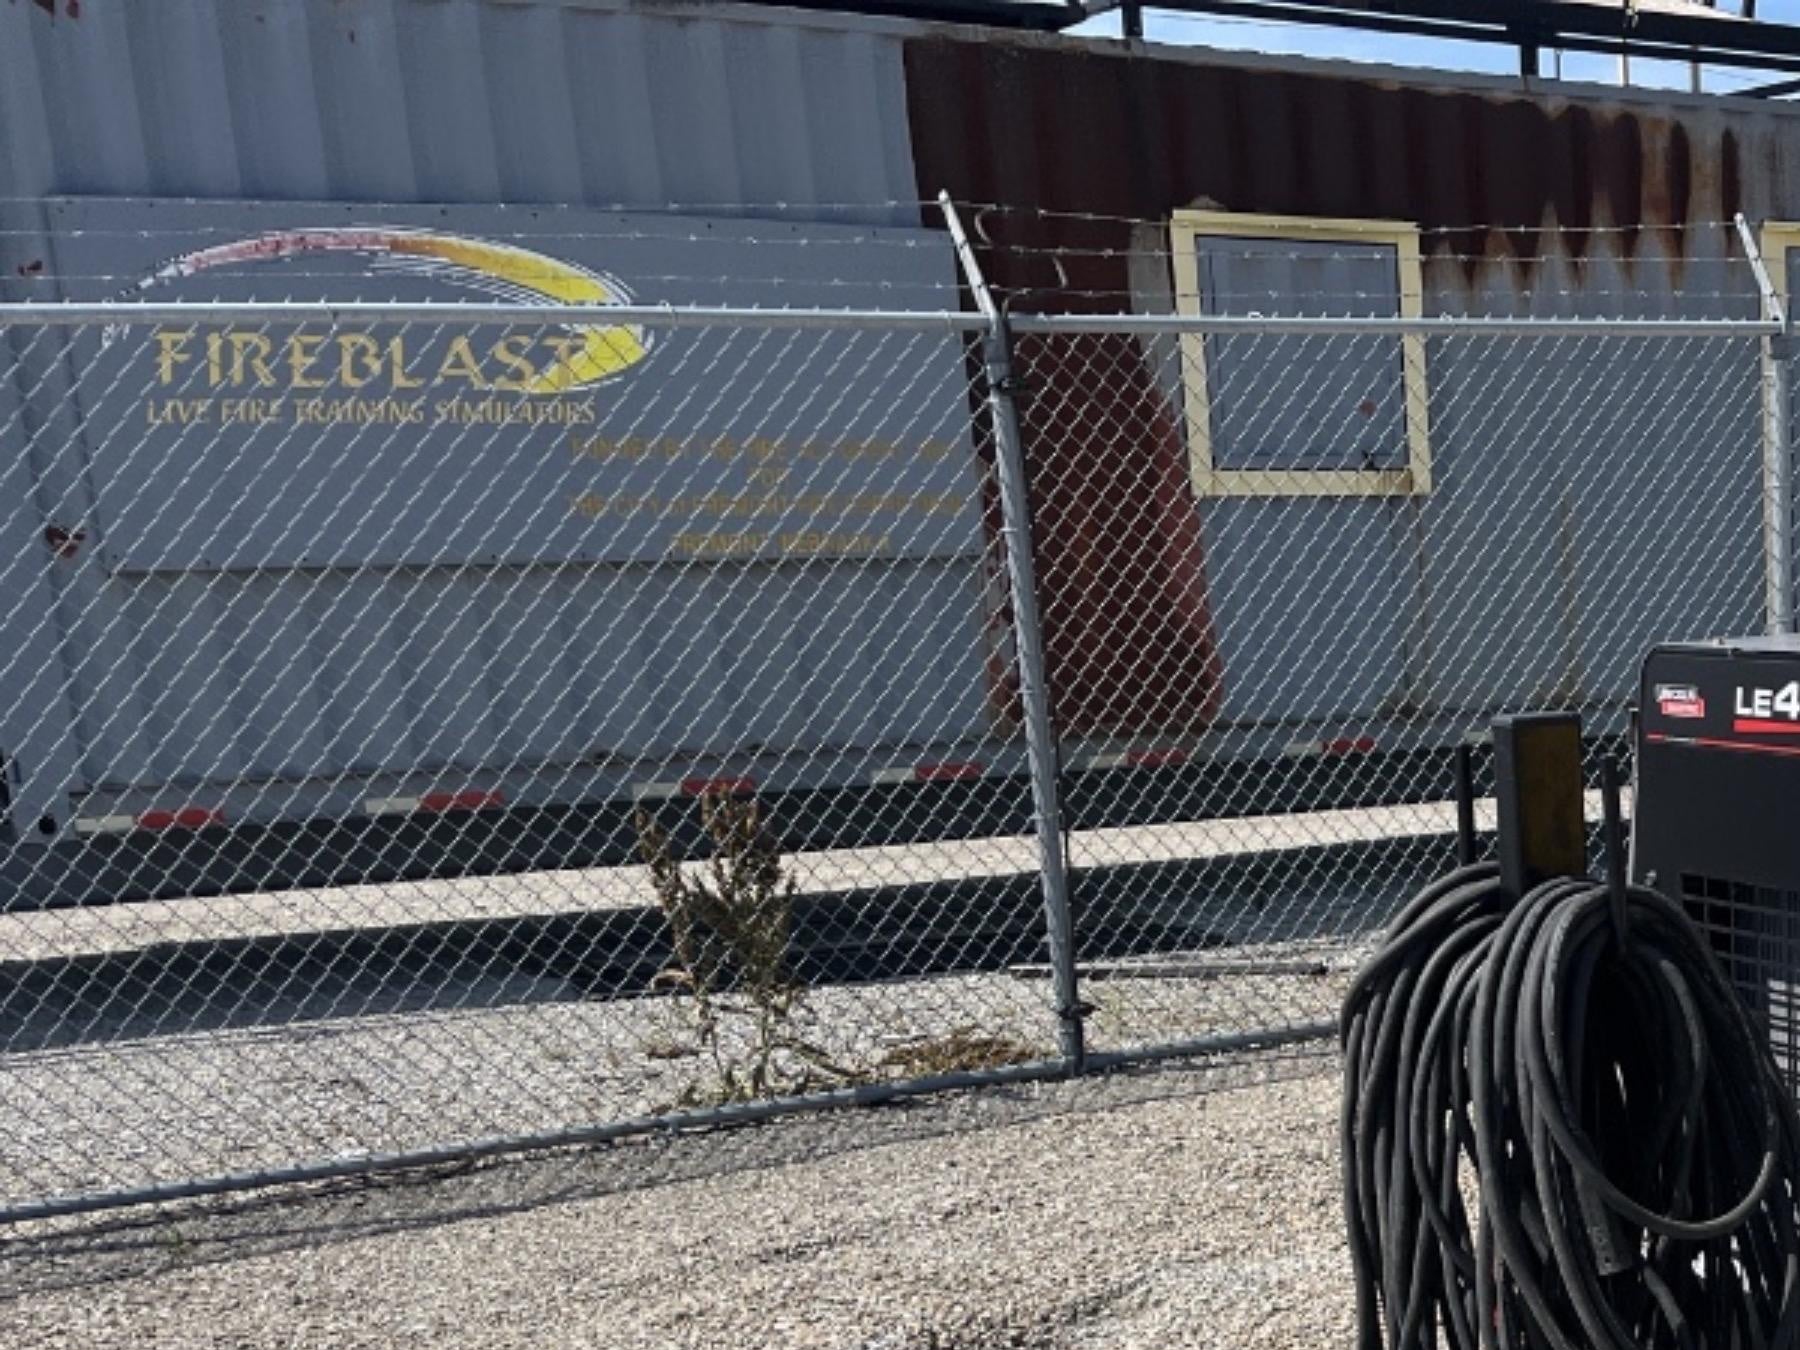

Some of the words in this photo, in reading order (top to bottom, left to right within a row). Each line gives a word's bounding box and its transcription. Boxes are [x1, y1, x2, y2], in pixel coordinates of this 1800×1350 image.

[153, 330, 588, 392] FIREBLAST
[146, 399, 209, 425] LIVE
[220, 399, 283, 424] FIRE
[294, 399, 425, 424] TRAINING
[434, 399, 596, 425] SIMULATORS
